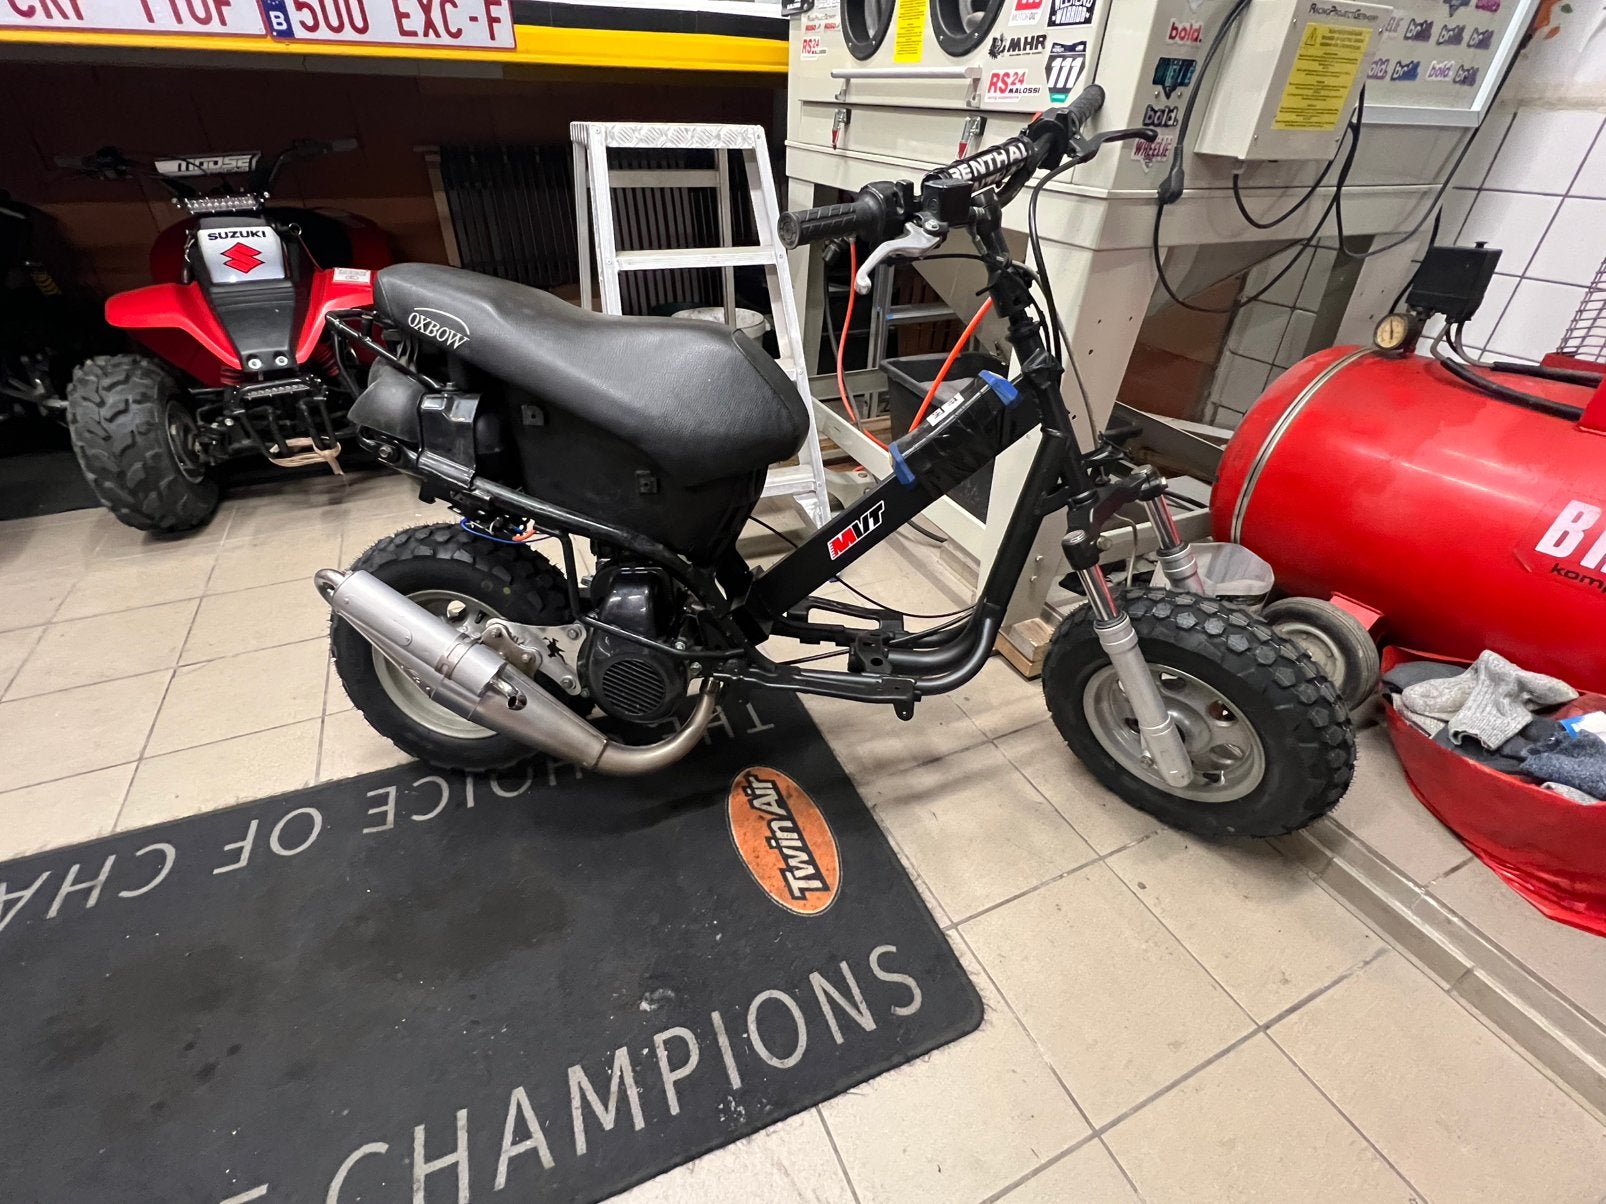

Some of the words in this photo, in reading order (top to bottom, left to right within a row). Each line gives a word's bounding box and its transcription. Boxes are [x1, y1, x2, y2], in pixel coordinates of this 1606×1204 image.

[269, 10, 287, 30] B
[294, 0, 370, 36] 500
[1168, 22, 1202, 43] bold.
[1007, 34, 1047, 53] MHR
[1048, 57, 1084, 88] 111
[208, 230, 266, 241] SUZUKI
[408, 312, 470, 350] OXBOW
[828, 501, 884, 560] MVT
[1551, 563, 1606, 594] kom
[213, 806, 323, 875] OF
[325, 945, 923, 1204] CHAMPIONS
